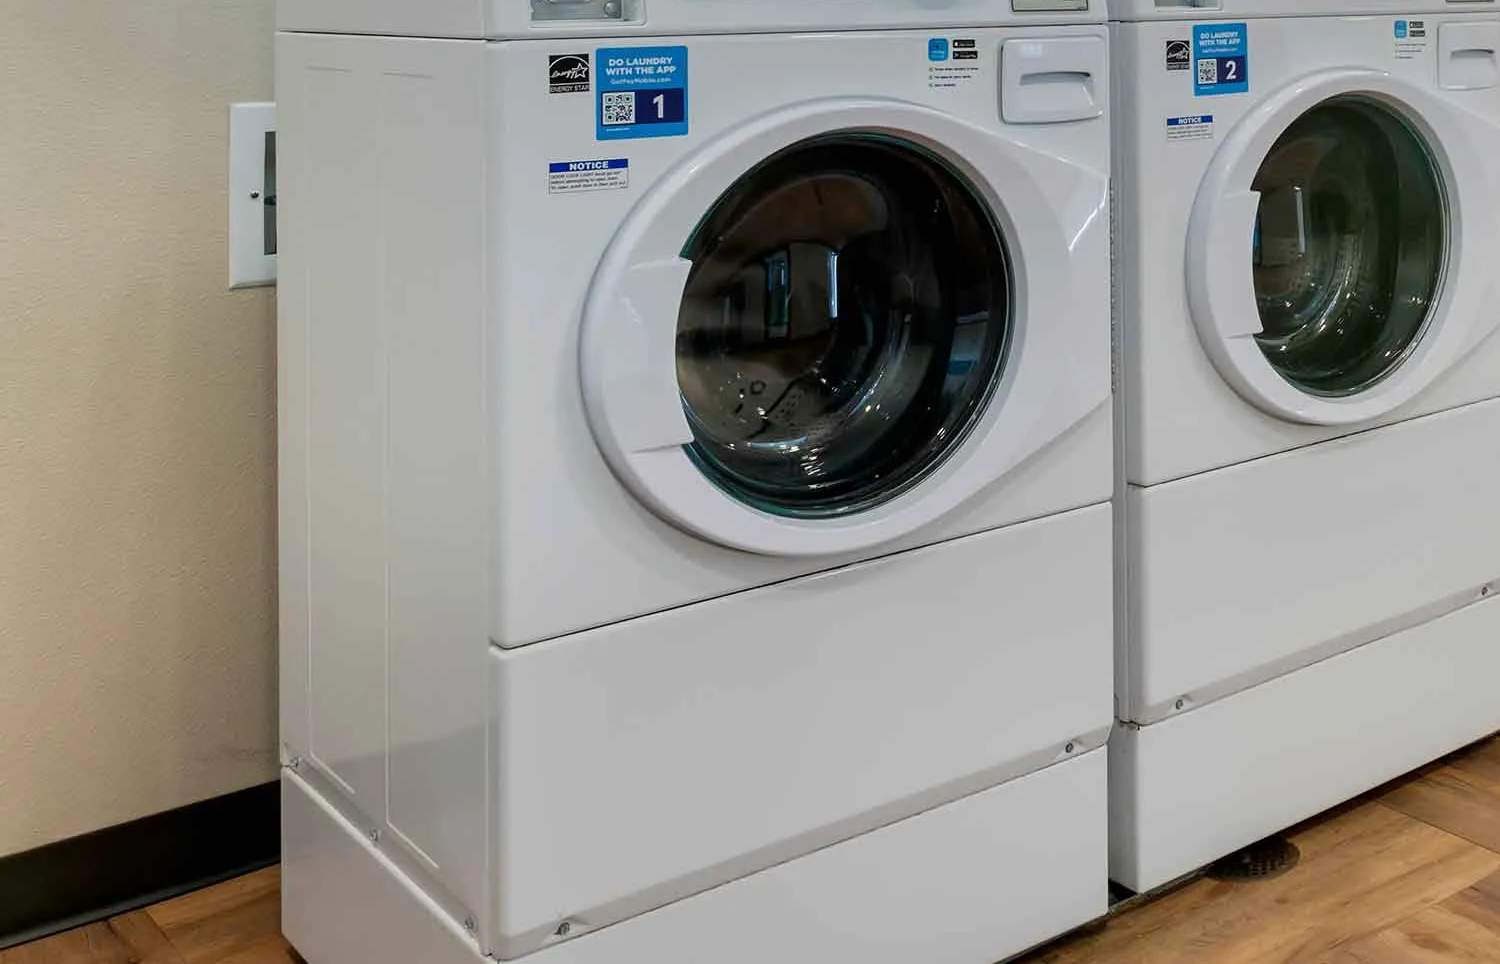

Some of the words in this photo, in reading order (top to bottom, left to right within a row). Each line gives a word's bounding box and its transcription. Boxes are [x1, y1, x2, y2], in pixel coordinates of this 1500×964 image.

[608, 58, 623, 67] DO
[625, 56, 673, 66] LAUNDRY
[605, 67, 633, 76] WITH
[635, 66, 654, 75] THE
[656, 65, 676, 74] APP
[1225, 60, 1237, 80] 2
[652, 93, 664, 119] 1
[569, 160, 609, 171] NOTICE
